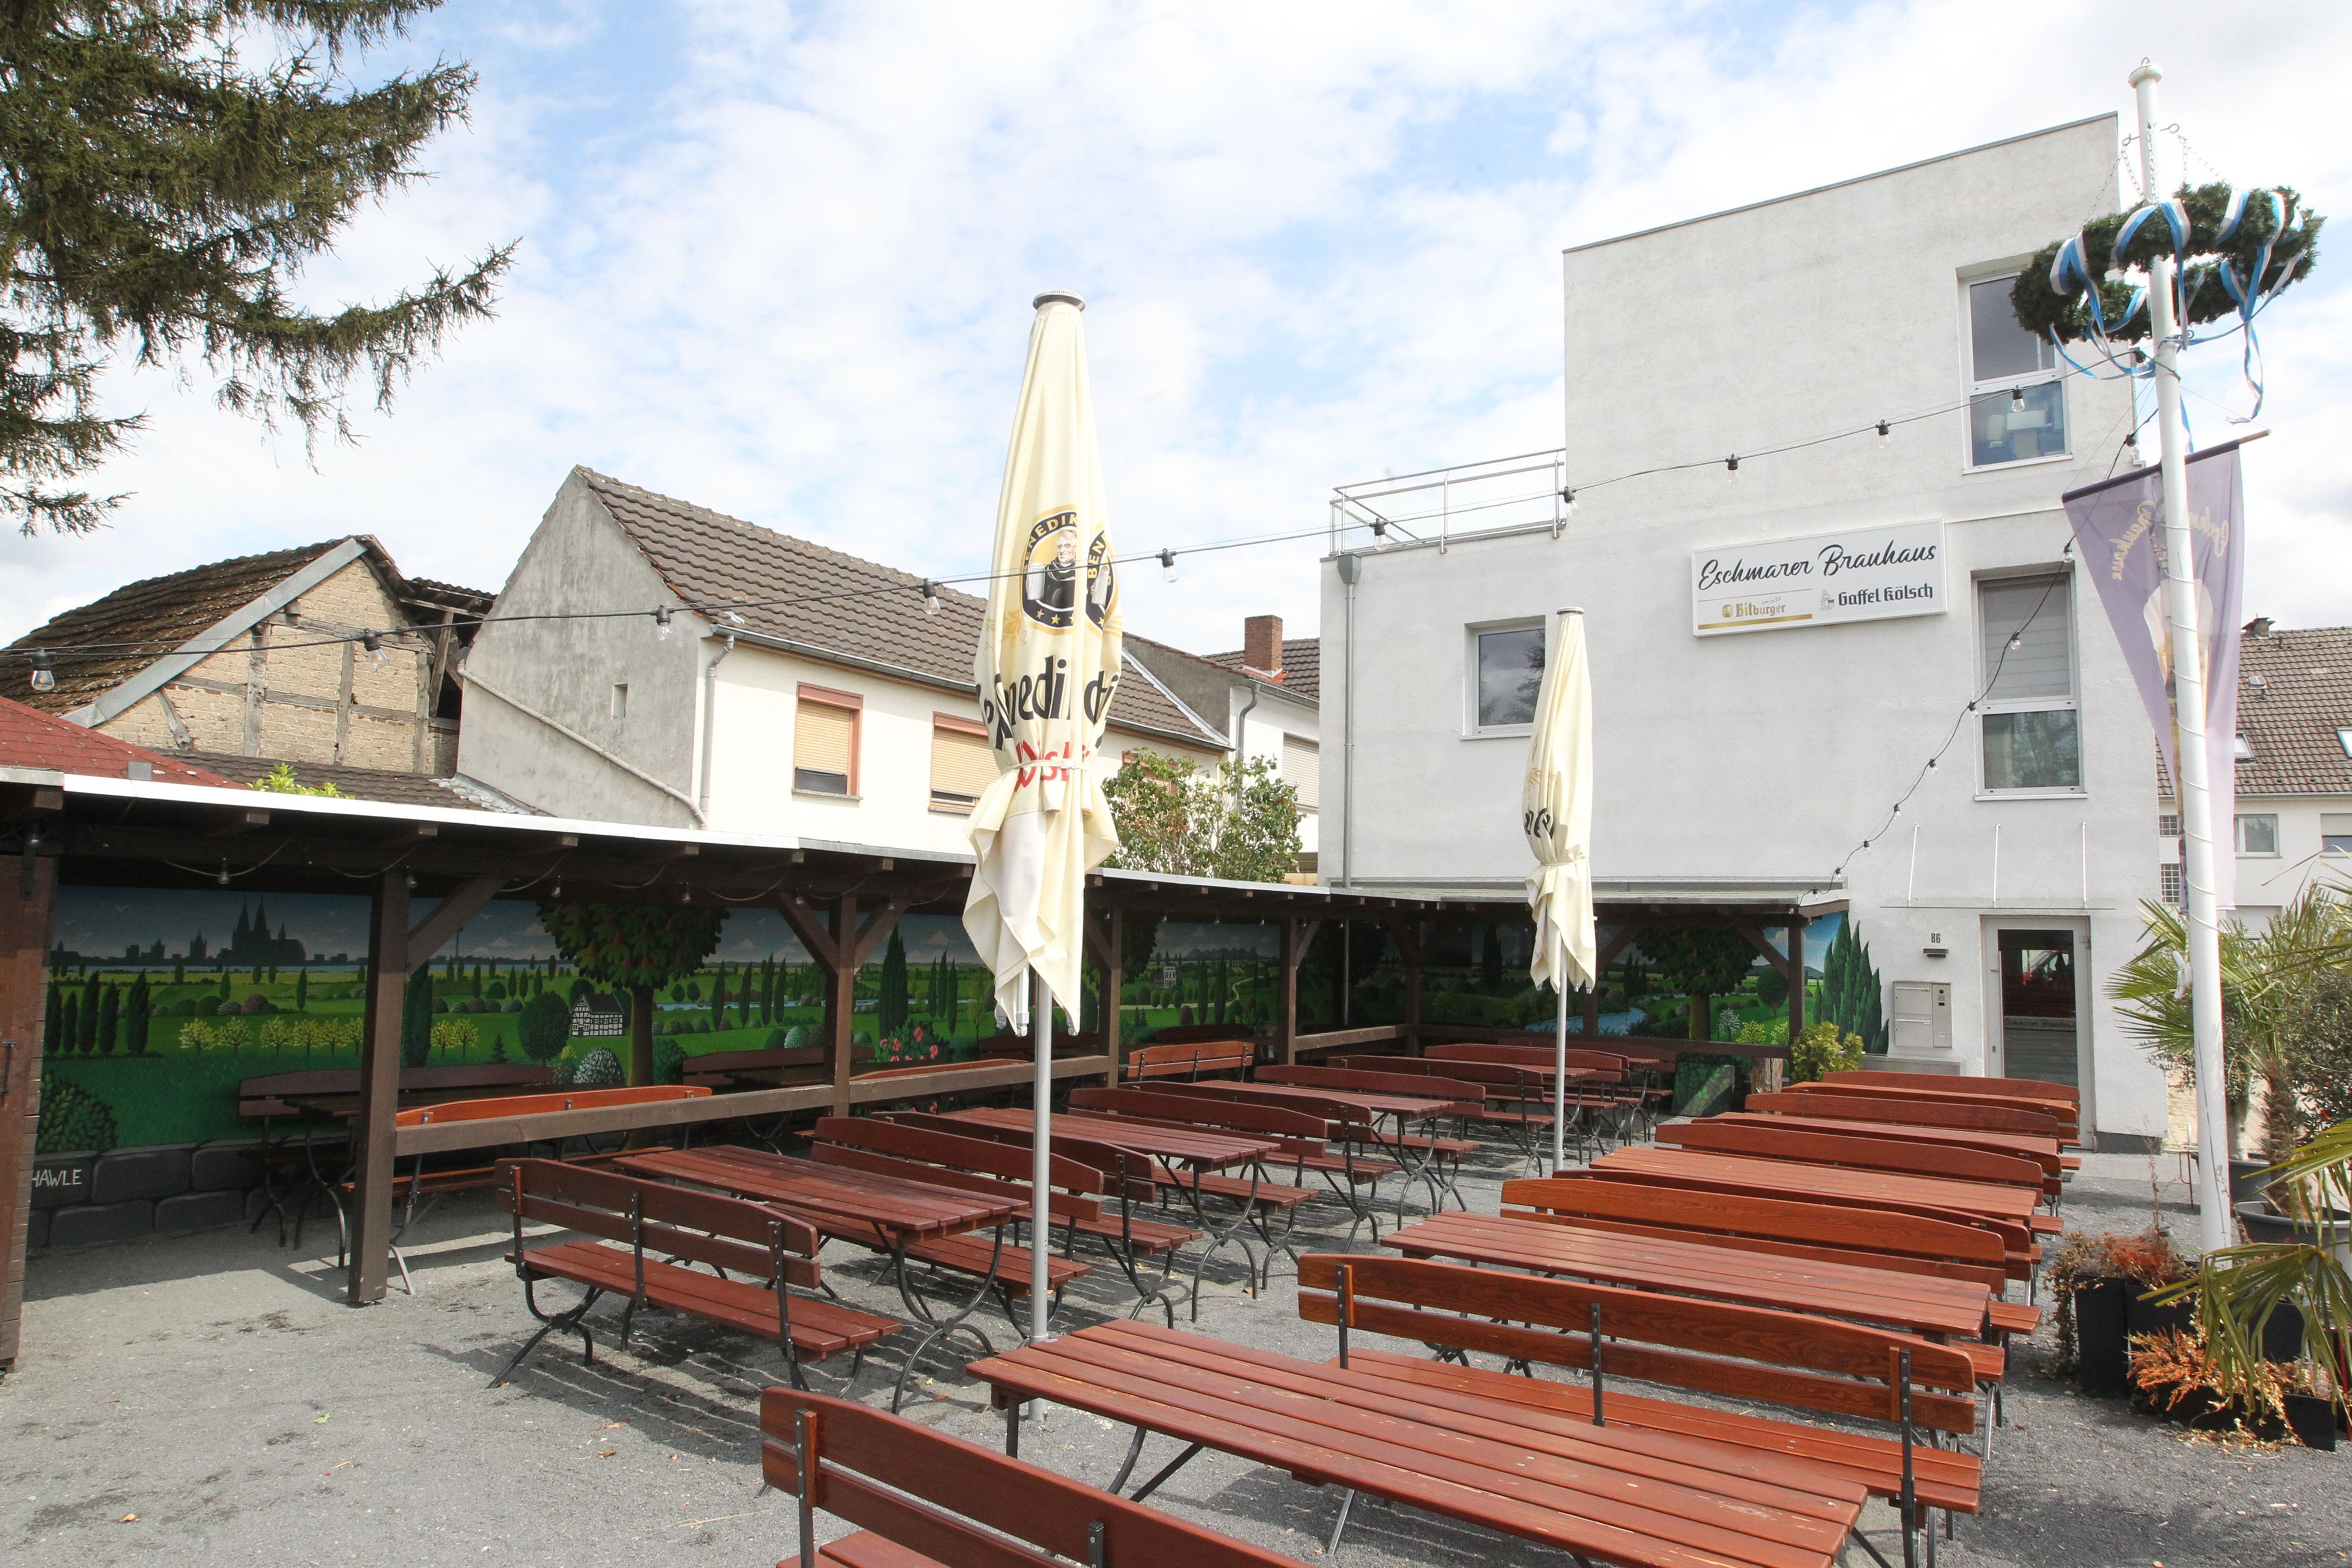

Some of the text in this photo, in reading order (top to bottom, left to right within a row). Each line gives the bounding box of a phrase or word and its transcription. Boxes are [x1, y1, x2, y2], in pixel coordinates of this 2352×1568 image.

[1698, 540, 1937, 590] Eschmarer Brauhaus
[1838, 583, 1933, 606] Gaffel Kölsch
[1735, 602, 1786, 617] Bitburger
[1931, 933, 1941, 944] 86
